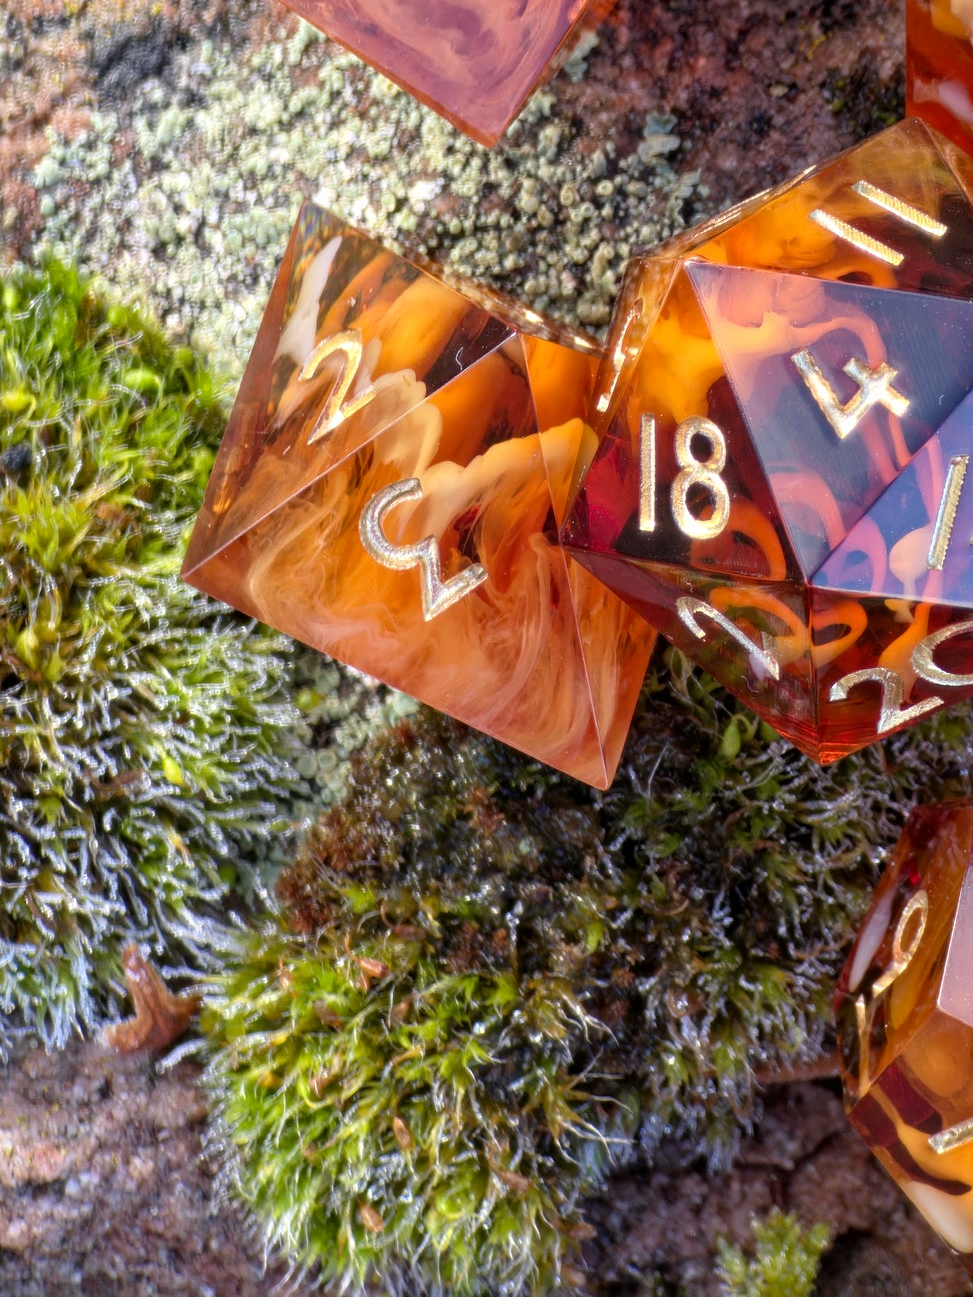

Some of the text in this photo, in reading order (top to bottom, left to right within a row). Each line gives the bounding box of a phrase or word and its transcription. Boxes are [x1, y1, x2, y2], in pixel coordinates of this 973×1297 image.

[809, 179, 947, 266] 11
[298, 328, 377, 446] 2
[790, 350, 910, 440] 4
[638, 412, 731, 540] 18
[357, 476, 489, 623] 3
